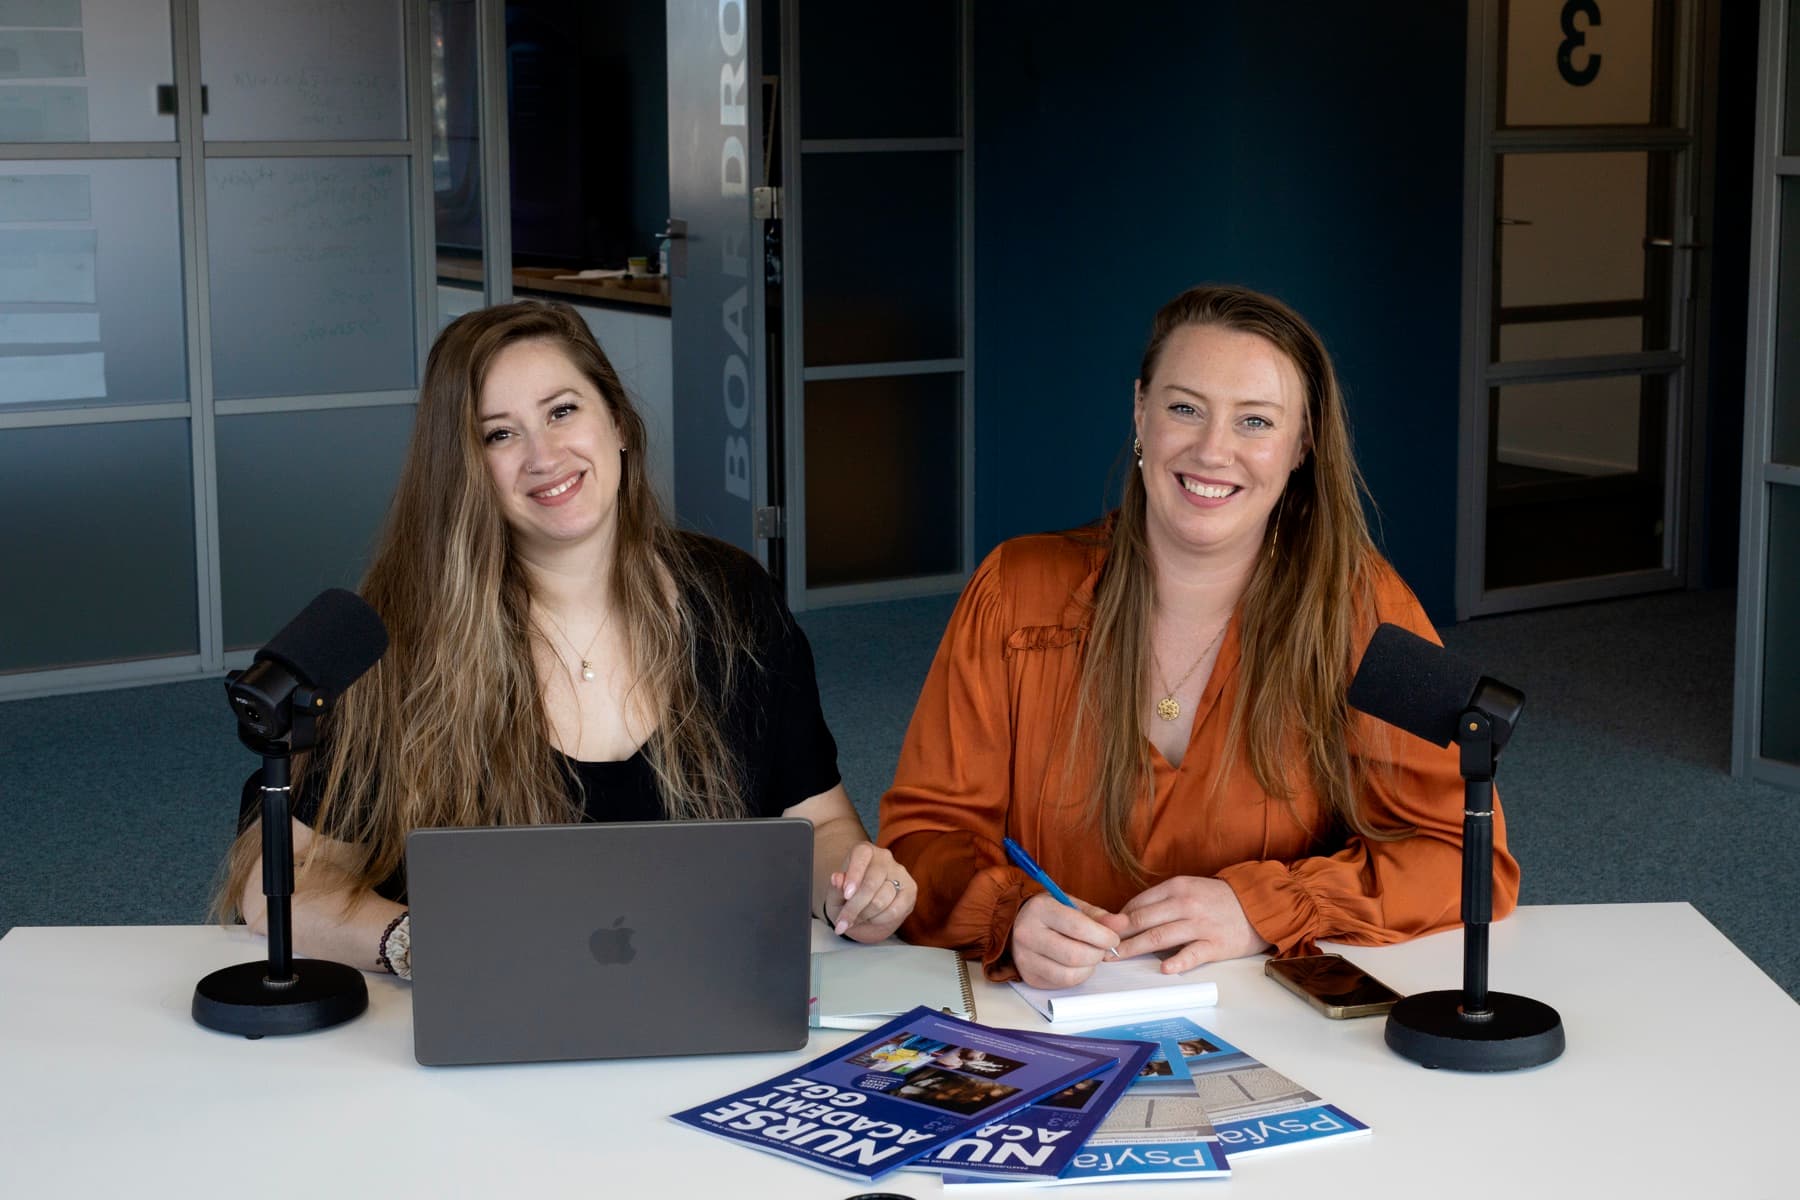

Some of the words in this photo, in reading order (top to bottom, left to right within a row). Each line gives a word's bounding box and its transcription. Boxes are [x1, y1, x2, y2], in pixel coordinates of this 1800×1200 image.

[774, 1078, 867, 1107] GGZ
[744, 1092, 936, 1145] ACADEMY
[1217, 1113, 1344, 1147] Psyfa
[701, 1102, 904, 1166] NURSE
[976, 1124, 1072, 1143] ACA
[926, 1139, 1057, 1166] NU
[1073, 1148, 1206, 1172] Psyfa
